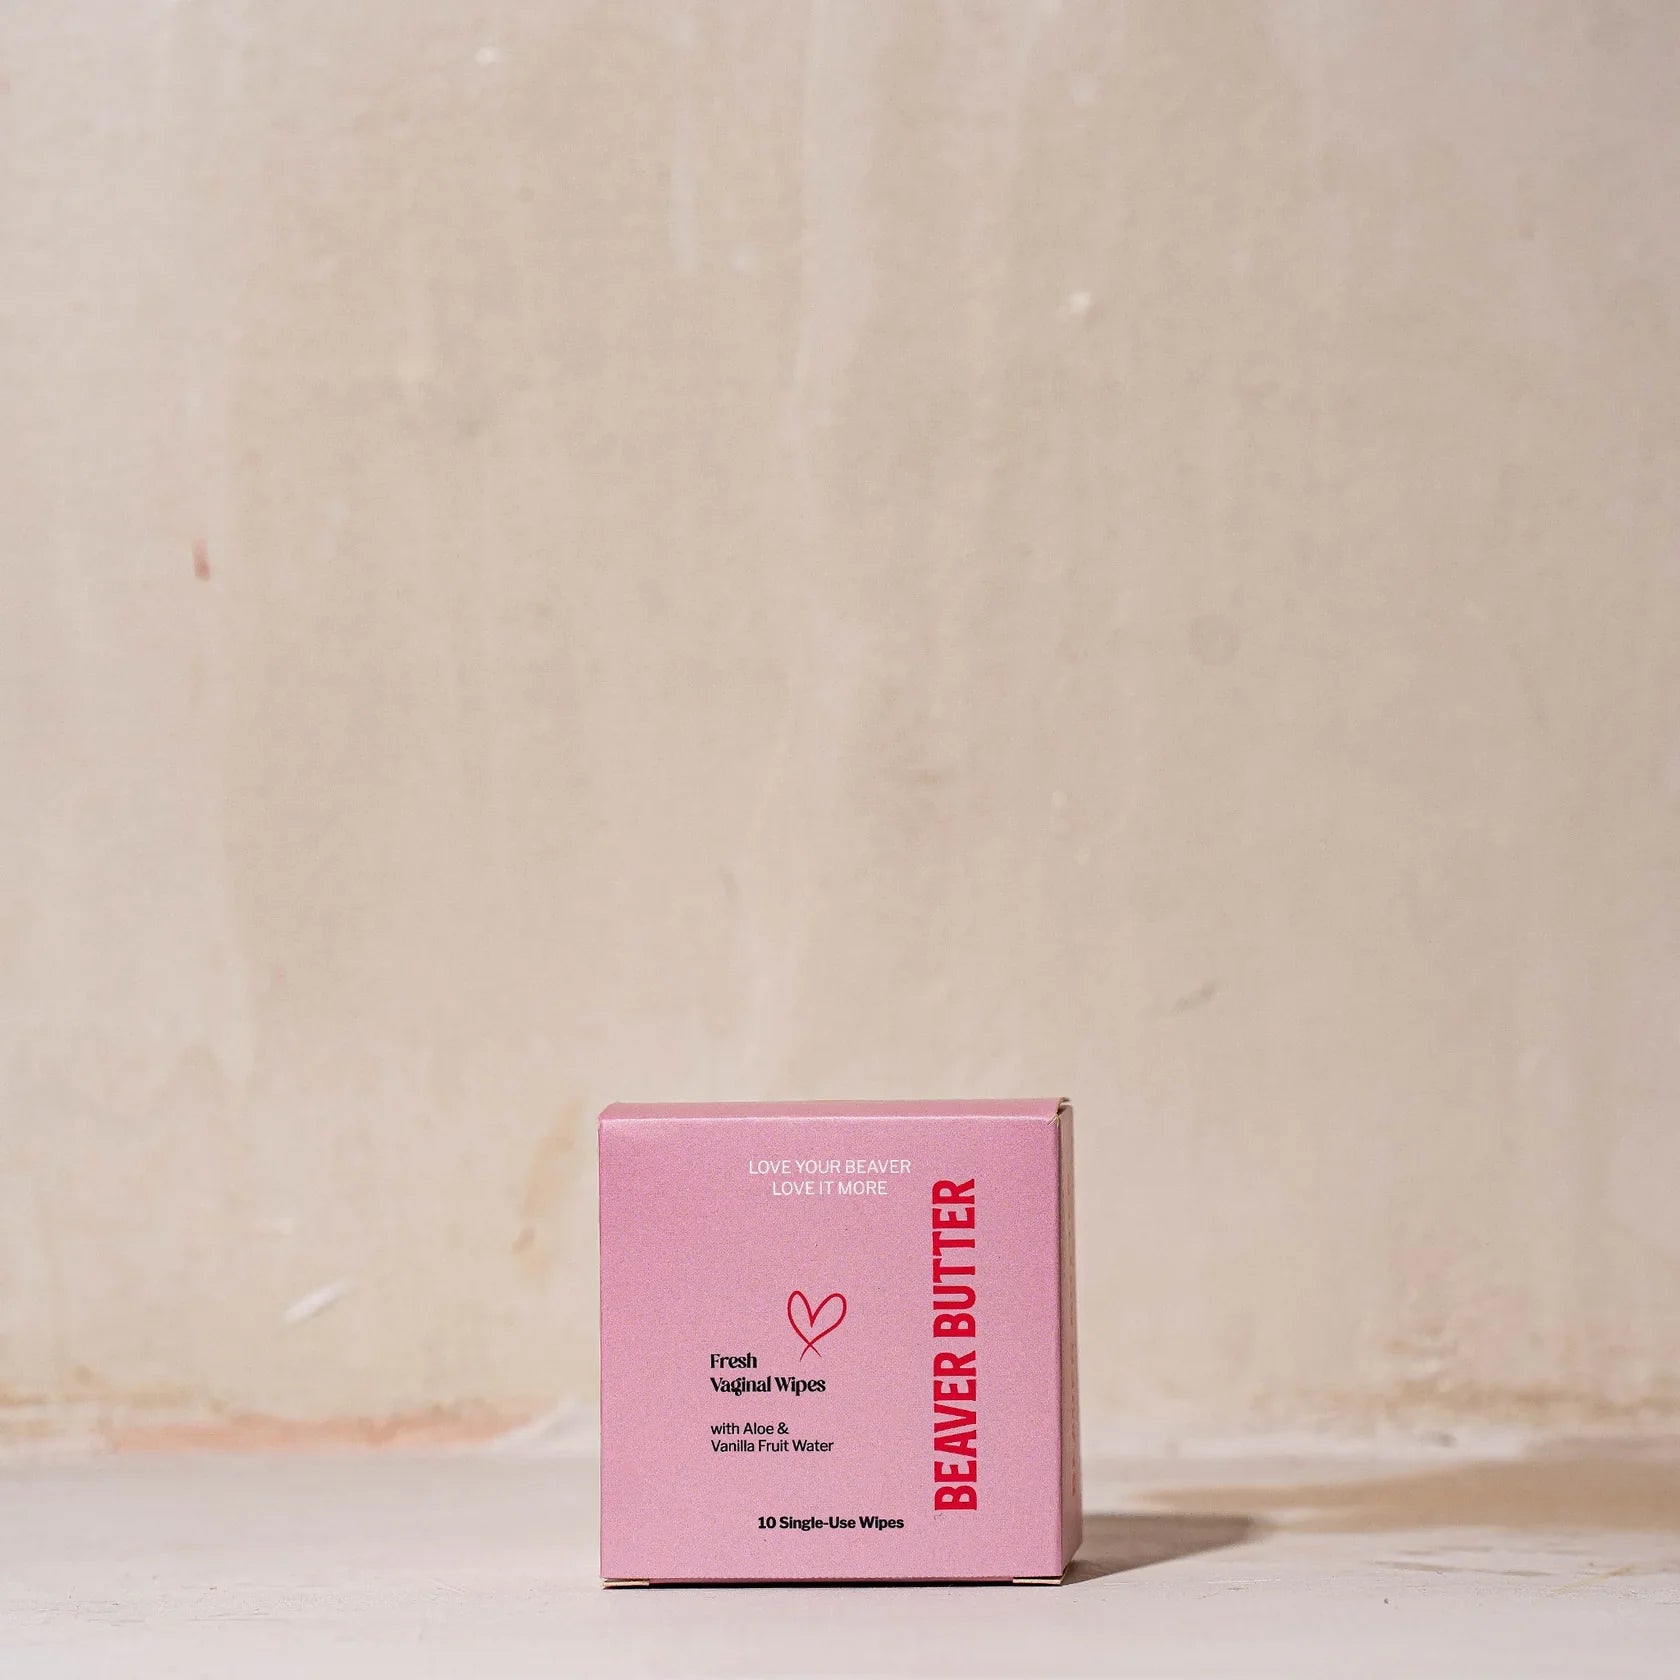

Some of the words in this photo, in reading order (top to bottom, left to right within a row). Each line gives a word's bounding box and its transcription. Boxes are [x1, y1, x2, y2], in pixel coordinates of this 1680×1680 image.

[749, 1160, 791, 1175] LOVE
[795, 1159, 841, 1174] YOUR
[845, 1159, 912, 1174] BEAVER
[772, 1181, 815, 1196] LOVE
[819, 1181, 834, 1195] IT
[838, 1180, 888, 1195] MORE
[931, 1178, 977, 1338] BUTTER
[709, 1352, 758, 1369] Fresh
[709, 1376, 772, 1396] Vaginal
[774, 1376, 827, 1396] Wipes
[710, 1422, 740, 1435] with
[743, 1422, 775, 1435] Aloe
[776, 1422, 790, 1435] &
[932, 1349, 978, 1511] BEAVER
[710, 1439, 755, 1452] Vanilla
[758, 1439, 790, 1452] Fruit
[791, 1439, 835, 1452] Water
[757, 1517, 777, 1530] 10
[779, 1516, 857, 1532] Single-Use
[858, 1516, 905, 1531] Wipes
